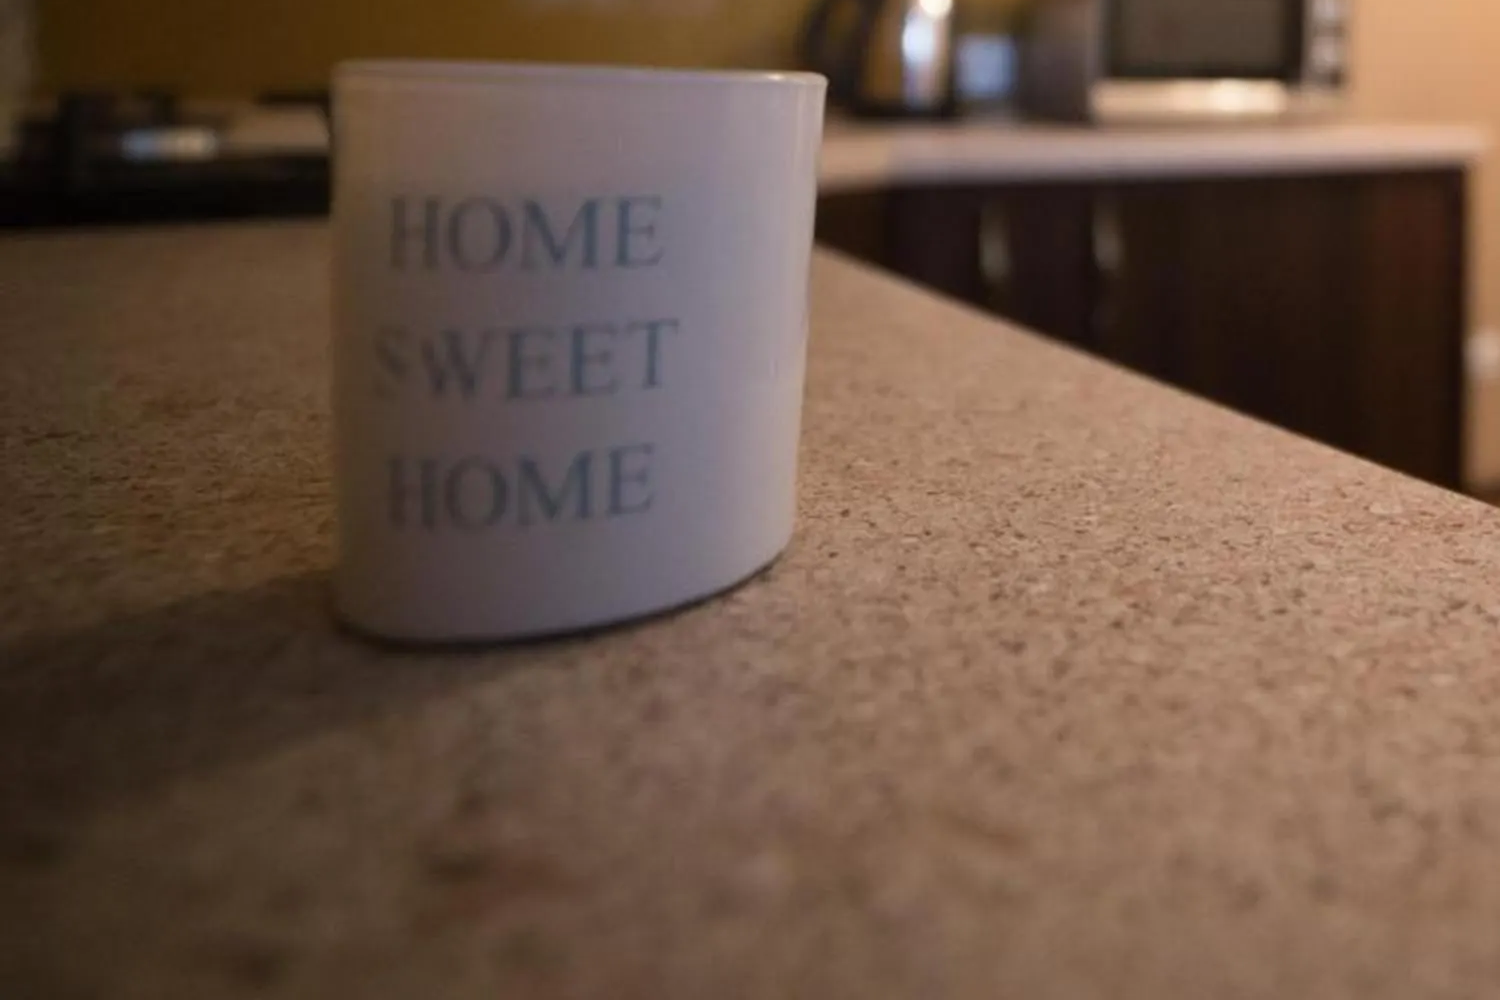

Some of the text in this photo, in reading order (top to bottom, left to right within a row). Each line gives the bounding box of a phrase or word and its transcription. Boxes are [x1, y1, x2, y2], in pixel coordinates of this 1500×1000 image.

[388, 194, 664, 273] HOME
[374, 318, 680, 401] SWEET
[386, 443, 656, 533] HOME
